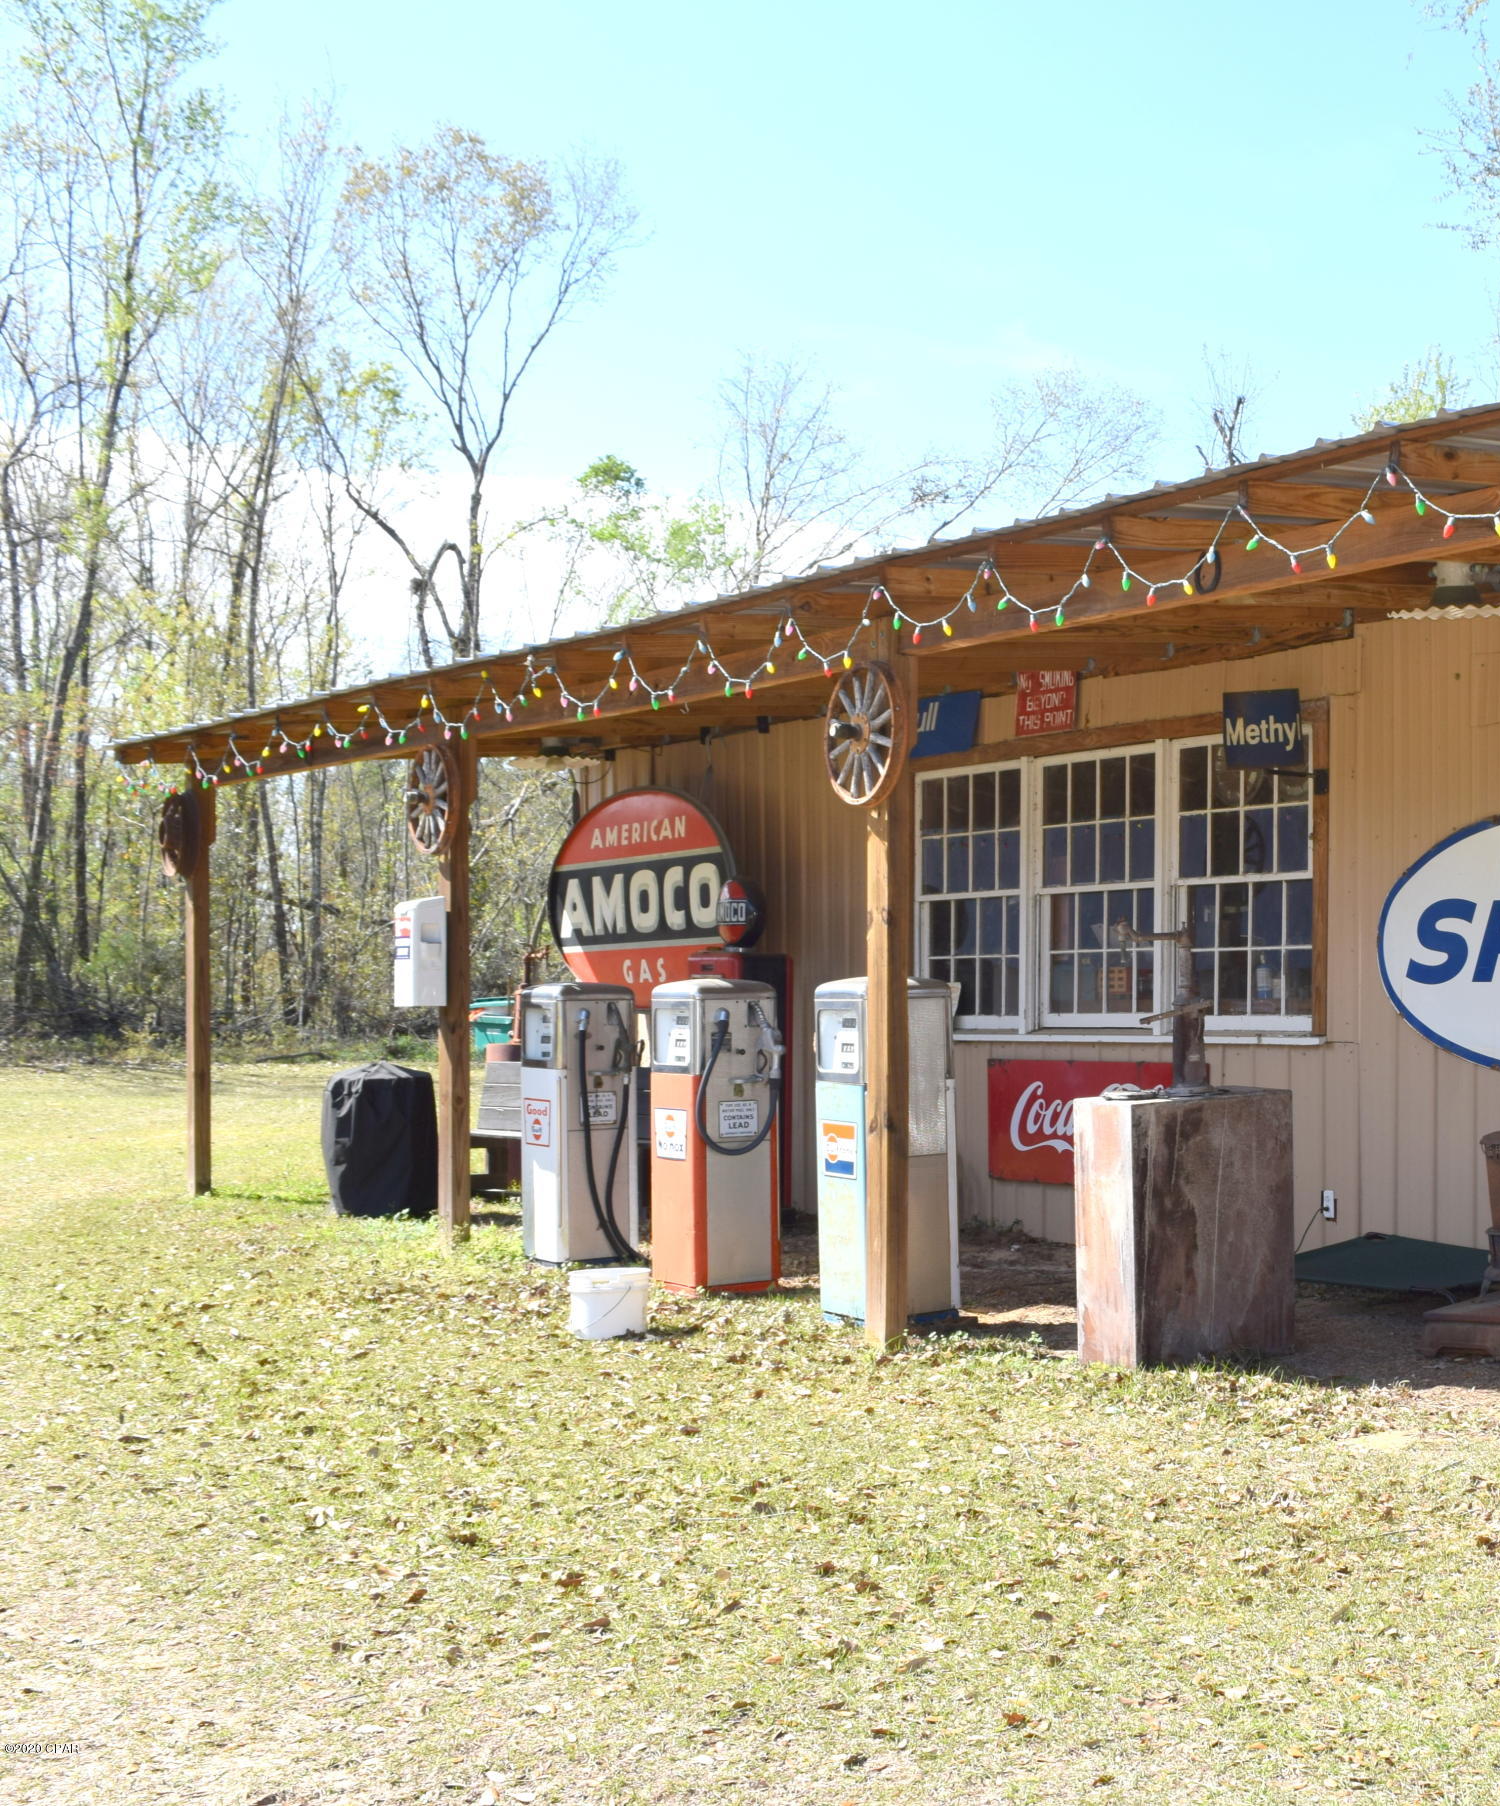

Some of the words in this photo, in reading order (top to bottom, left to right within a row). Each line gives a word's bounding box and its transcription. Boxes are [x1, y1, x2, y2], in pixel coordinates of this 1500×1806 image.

[1018, 714, 1041, 730] THIS
[590, 816, 687, 849] AMERICAN
[560, 862, 721, 938] AMOCO
[622, 957, 667, 984] GAS
[527, 1104, 548, 1116] Good
[728, 1121, 749, 1130] LEAD
